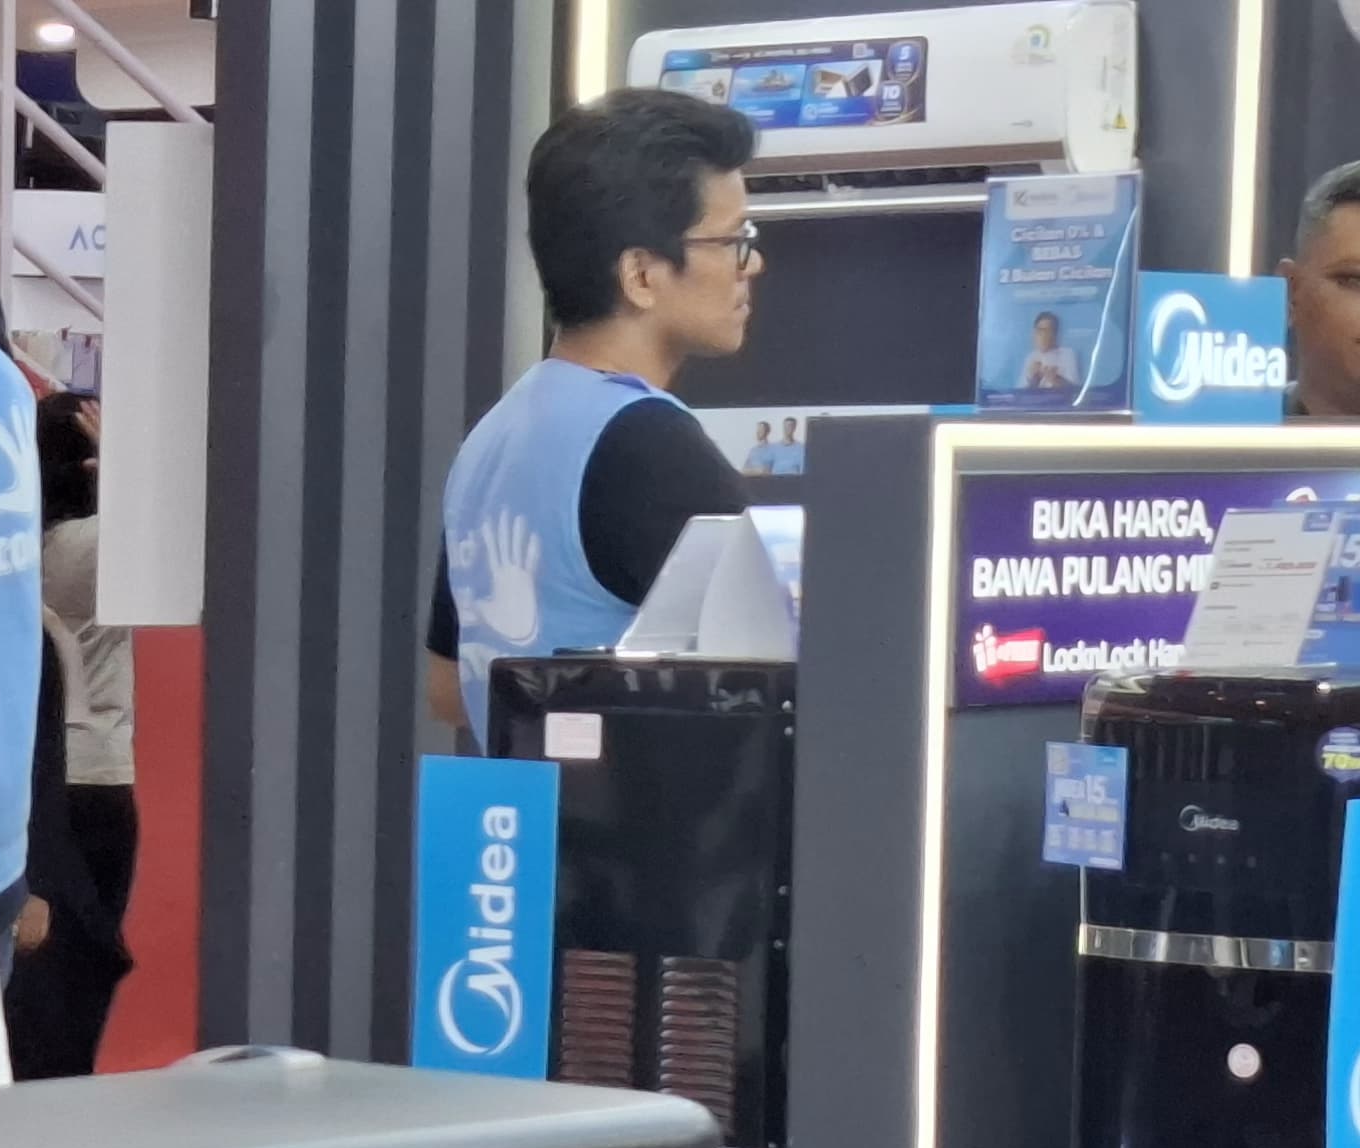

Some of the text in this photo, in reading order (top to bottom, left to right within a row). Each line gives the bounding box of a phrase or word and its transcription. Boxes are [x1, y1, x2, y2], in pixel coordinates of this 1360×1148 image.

[1149, 292, 1288, 402] Midea
[1033, 498, 1214, 545] BUKA HARGA,
[973, 556, 1057, 598] BAWA
[1063, 553, 1171, 595] PULANG
[438, 806, 523, 1056] Midea
